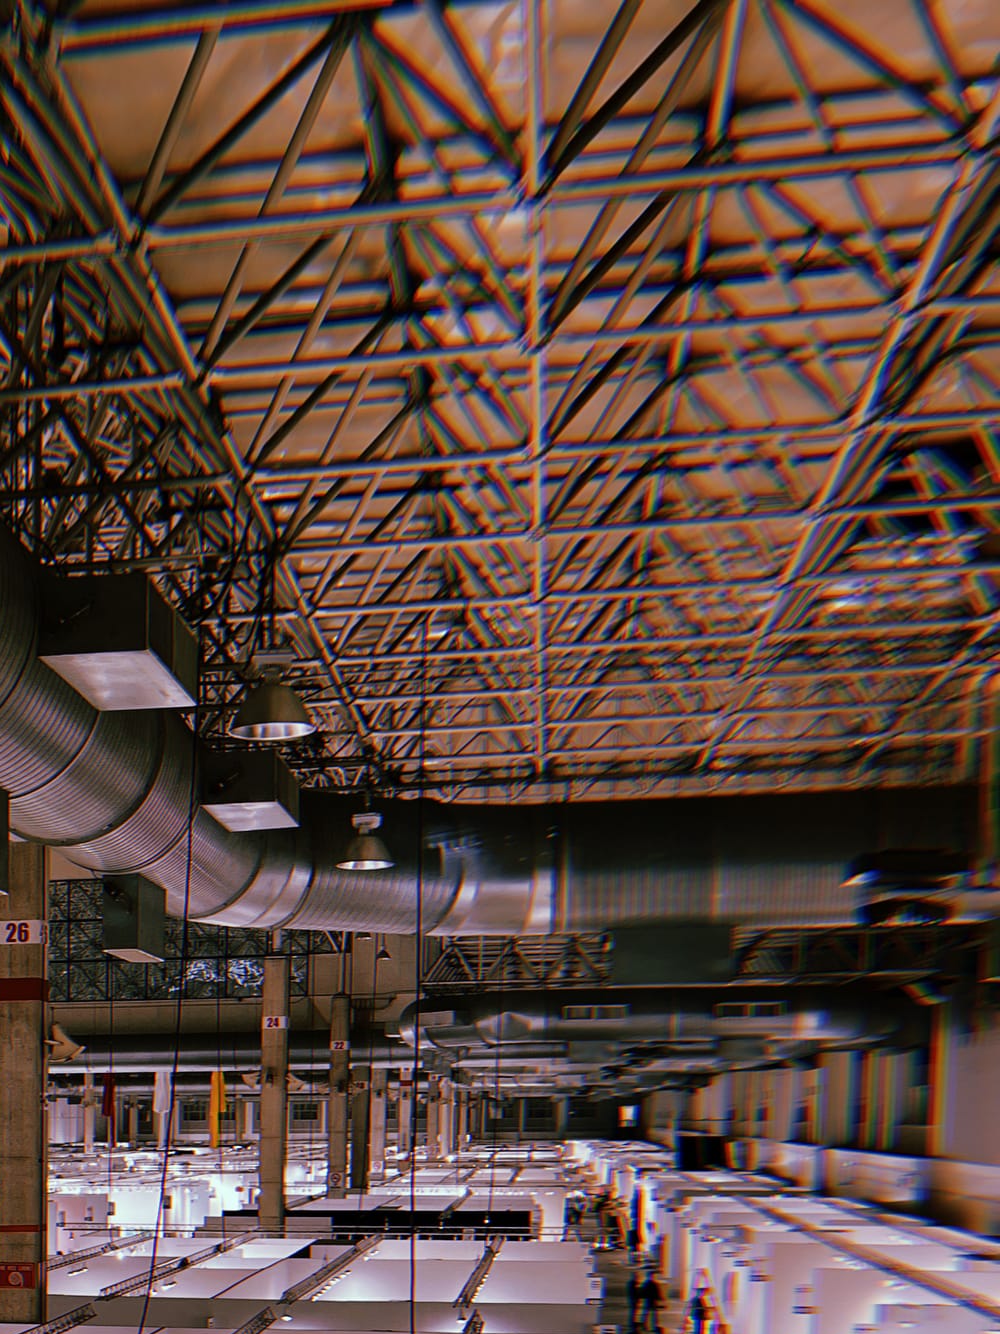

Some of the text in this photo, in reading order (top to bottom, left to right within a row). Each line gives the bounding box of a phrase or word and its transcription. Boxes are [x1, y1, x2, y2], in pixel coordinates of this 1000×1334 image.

[5, 922, 30, 943] 26
[266, 1017, 280, 1028] 24
[333, 1041, 345, 1050] 22
